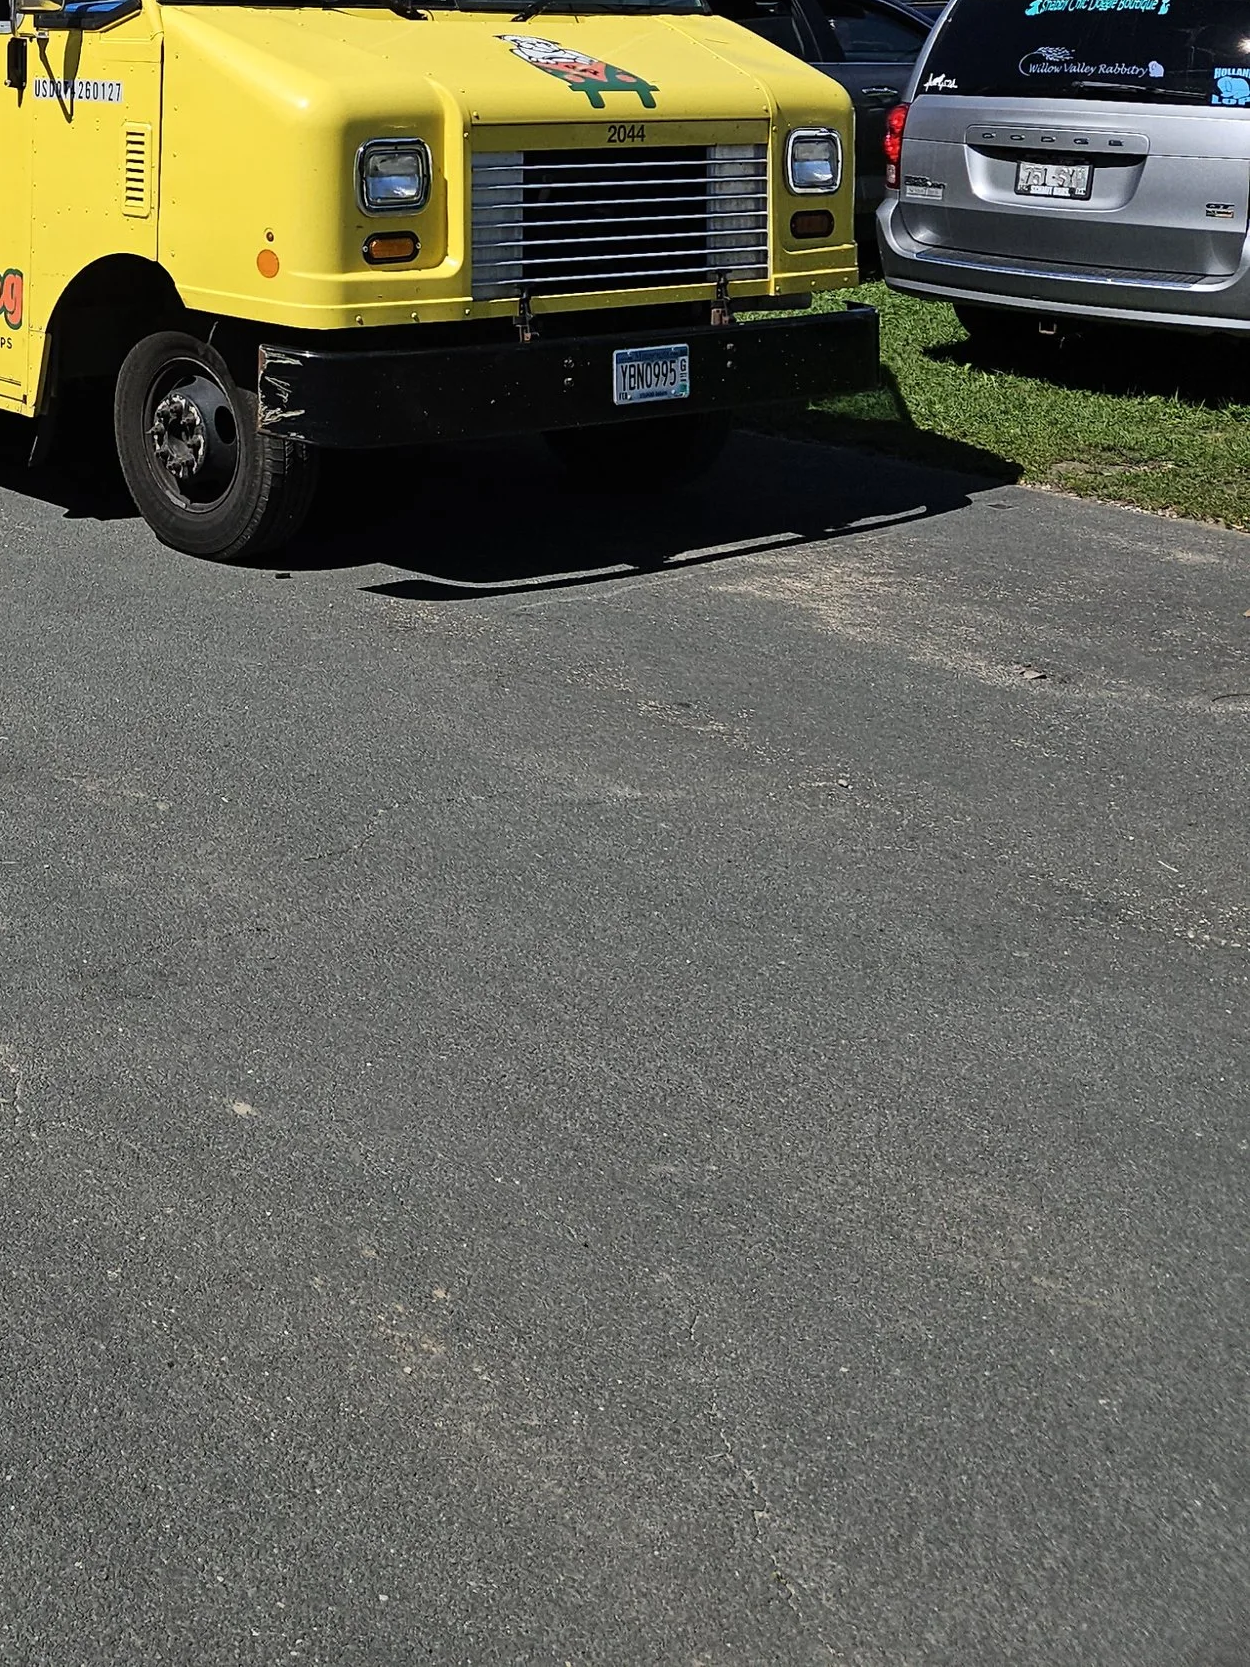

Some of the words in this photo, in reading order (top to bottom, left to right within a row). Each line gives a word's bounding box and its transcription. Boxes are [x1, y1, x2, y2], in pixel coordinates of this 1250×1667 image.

[1029, 62, 1062, 74] Willow
[1064, 62, 1097, 76] Valley
[1098, 62, 1148, 78] Rabbitry
[1214, 67, 1250, 80] HOLLAN
[607, 124, 646, 143] 2044
[620, 359, 677, 392] YBN0995
